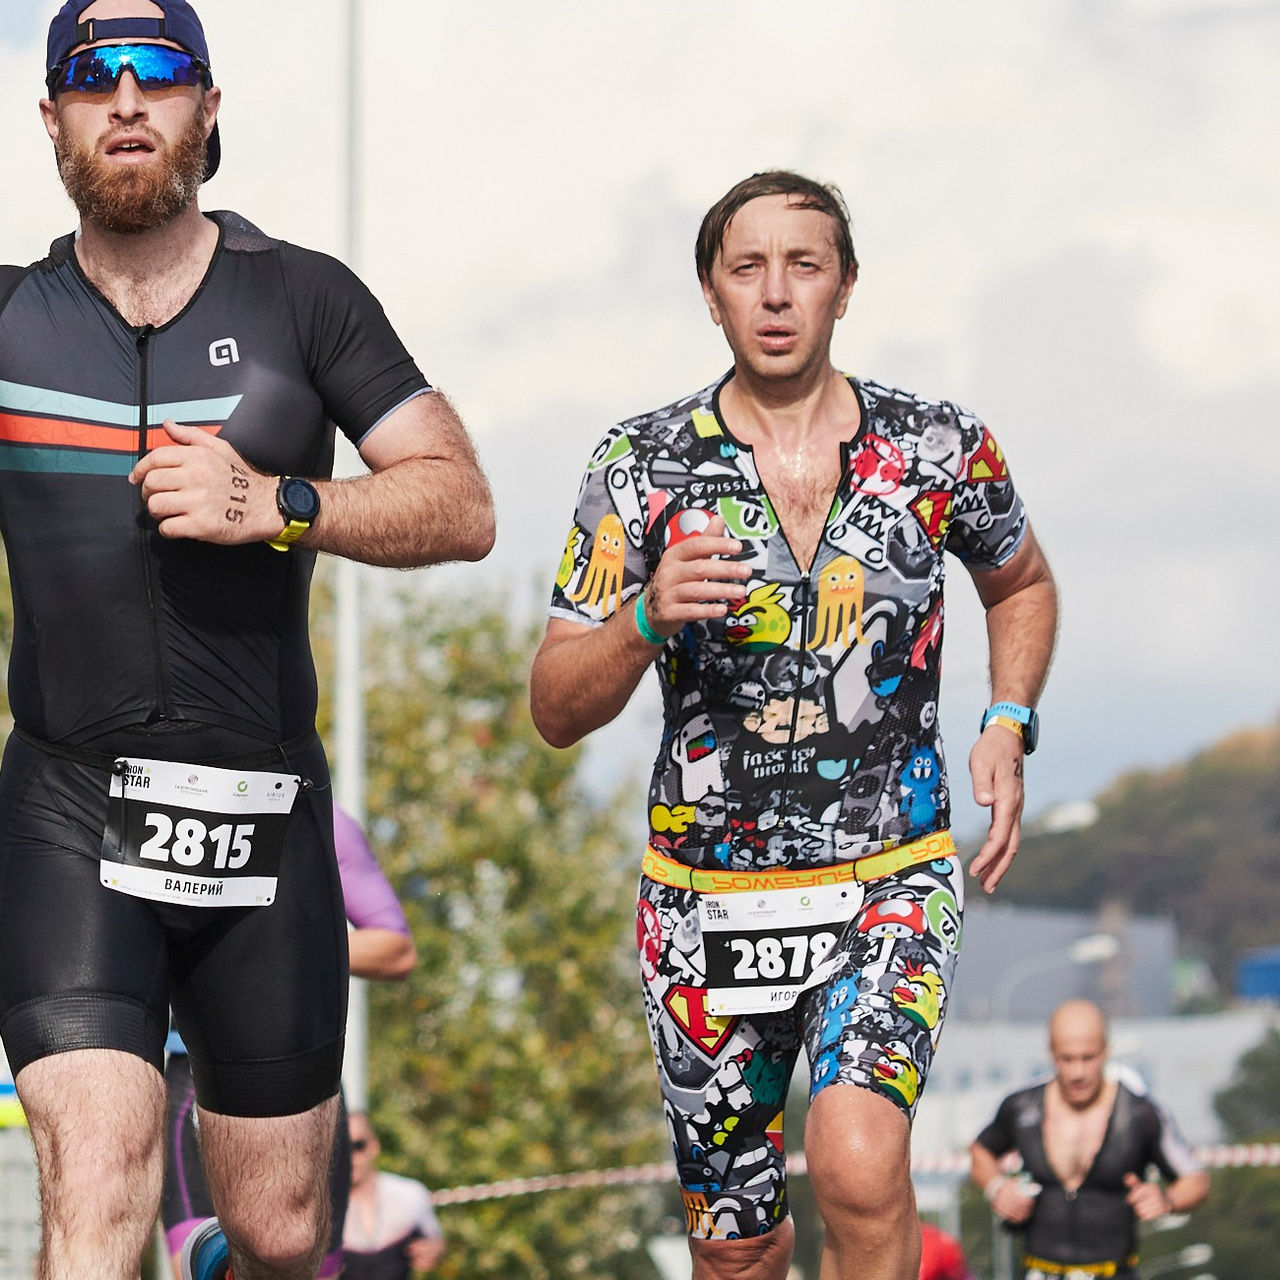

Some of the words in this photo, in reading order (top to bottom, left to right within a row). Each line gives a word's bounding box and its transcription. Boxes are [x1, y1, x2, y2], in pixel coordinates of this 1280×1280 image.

[225, 464, 249, 524] 2815
[123, 774, 151, 789] STAR
[139, 812, 256, 869] 2815
[164, 878, 224, 896] ВАЛЕРИЙ
[705, 900, 720, 909] IRON
[707, 909, 729, 920] STAR
[730, 932, 838, 980] 2878
[770, 991, 800, 1002] ИГОР
